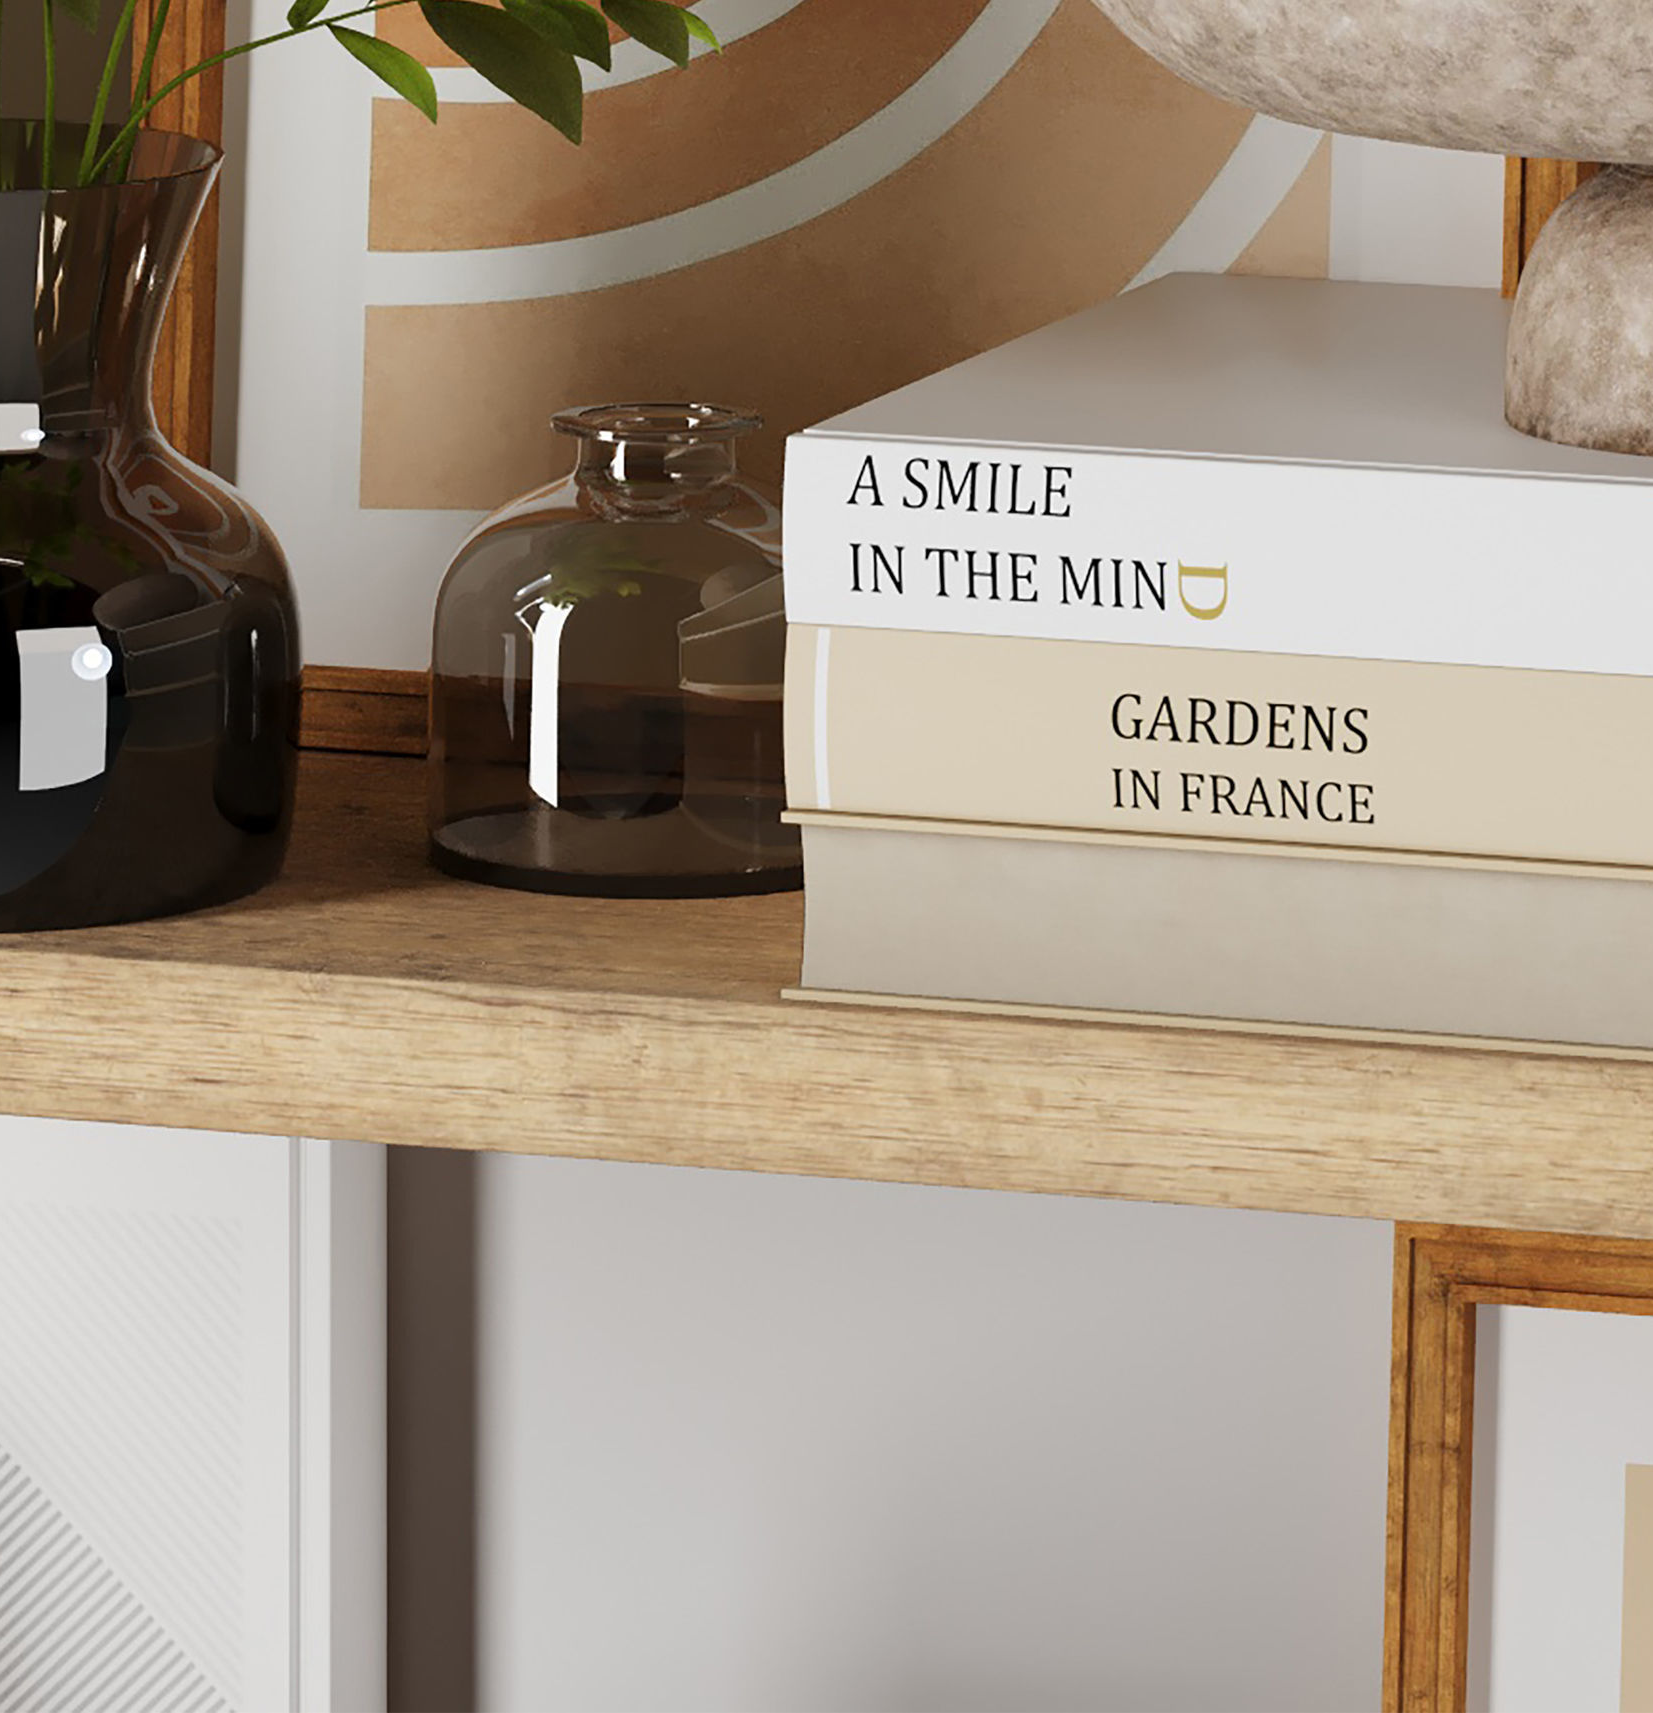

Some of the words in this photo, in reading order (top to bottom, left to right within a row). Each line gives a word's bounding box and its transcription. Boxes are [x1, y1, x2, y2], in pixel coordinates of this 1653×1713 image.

[845, 454, 885, 507] A
[901, 456, 1074, 518] SMILE
[849, 542, 906, 595] IN
[924, 547, 1039, 603] THE
[1058, 555, 1229, 621] MIND
[1111, 693, 1370, 755] GARDENS
[1111, 767, 1161, 811] IN
[1179, 772, 1375, 825] FRANCE
